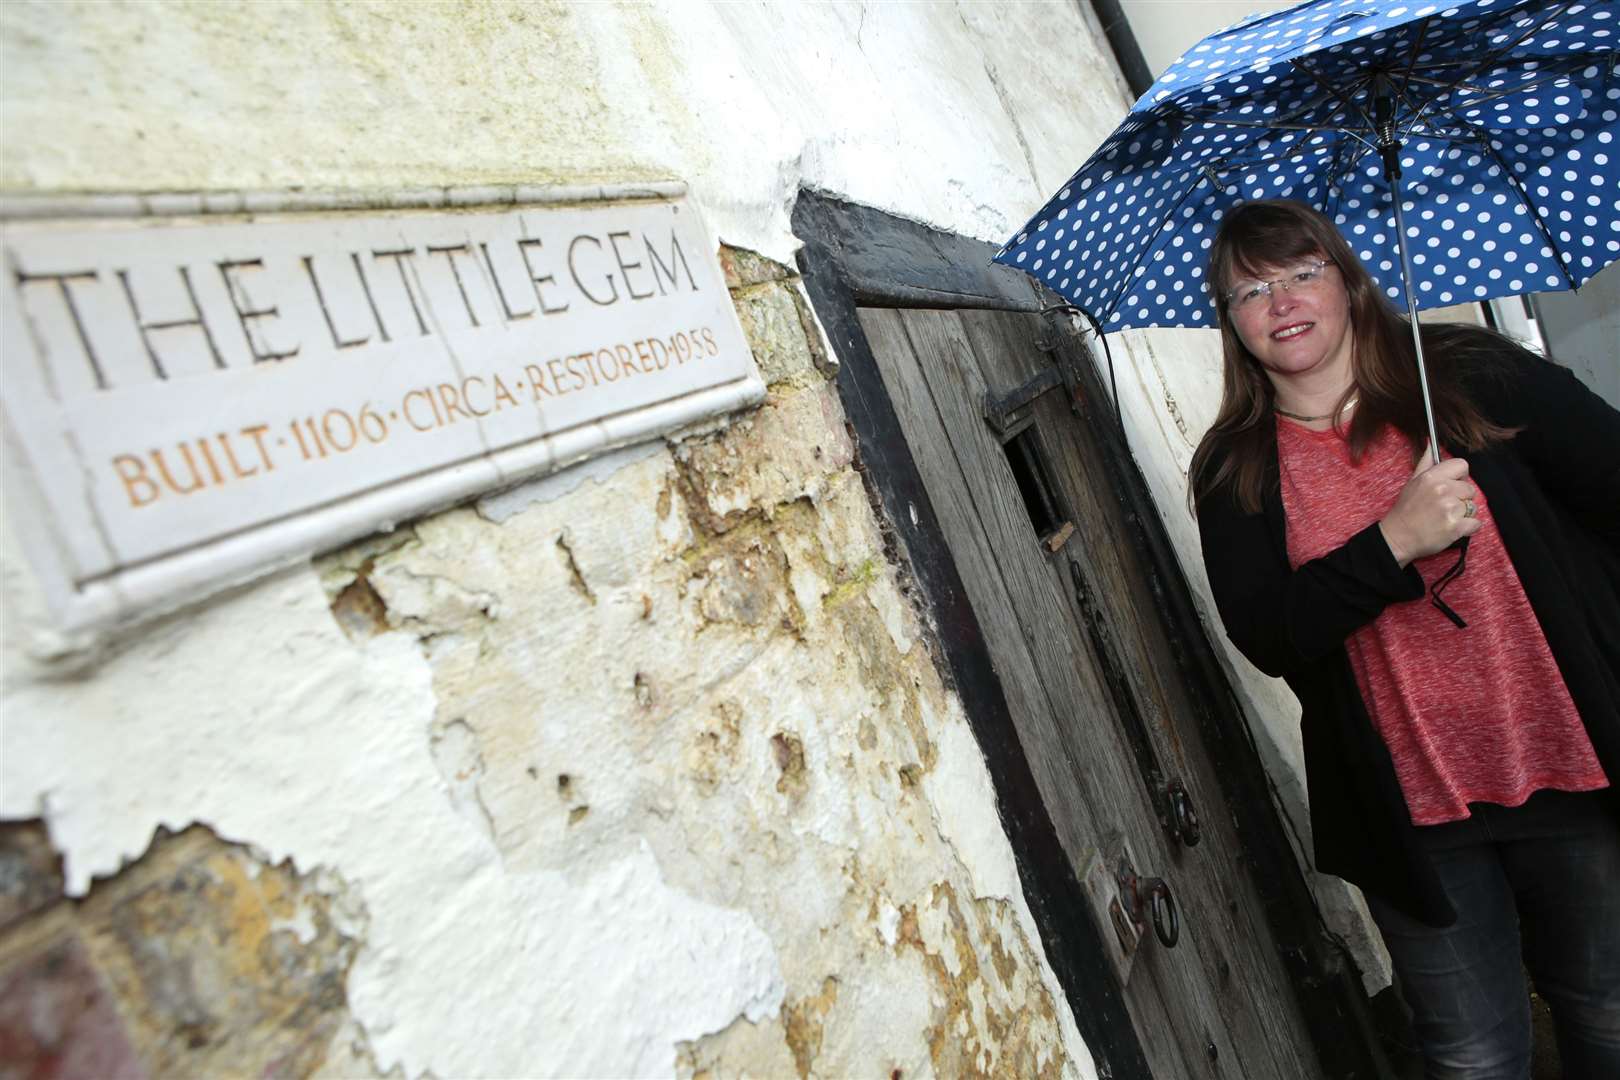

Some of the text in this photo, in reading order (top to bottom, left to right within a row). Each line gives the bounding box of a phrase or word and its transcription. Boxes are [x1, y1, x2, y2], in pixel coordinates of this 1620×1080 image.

[15, 228, 699, 390] THE LITTLE GEM
[112, 424, 277, 508] BUILT
[403, 373, 518, 432] CIRCA
